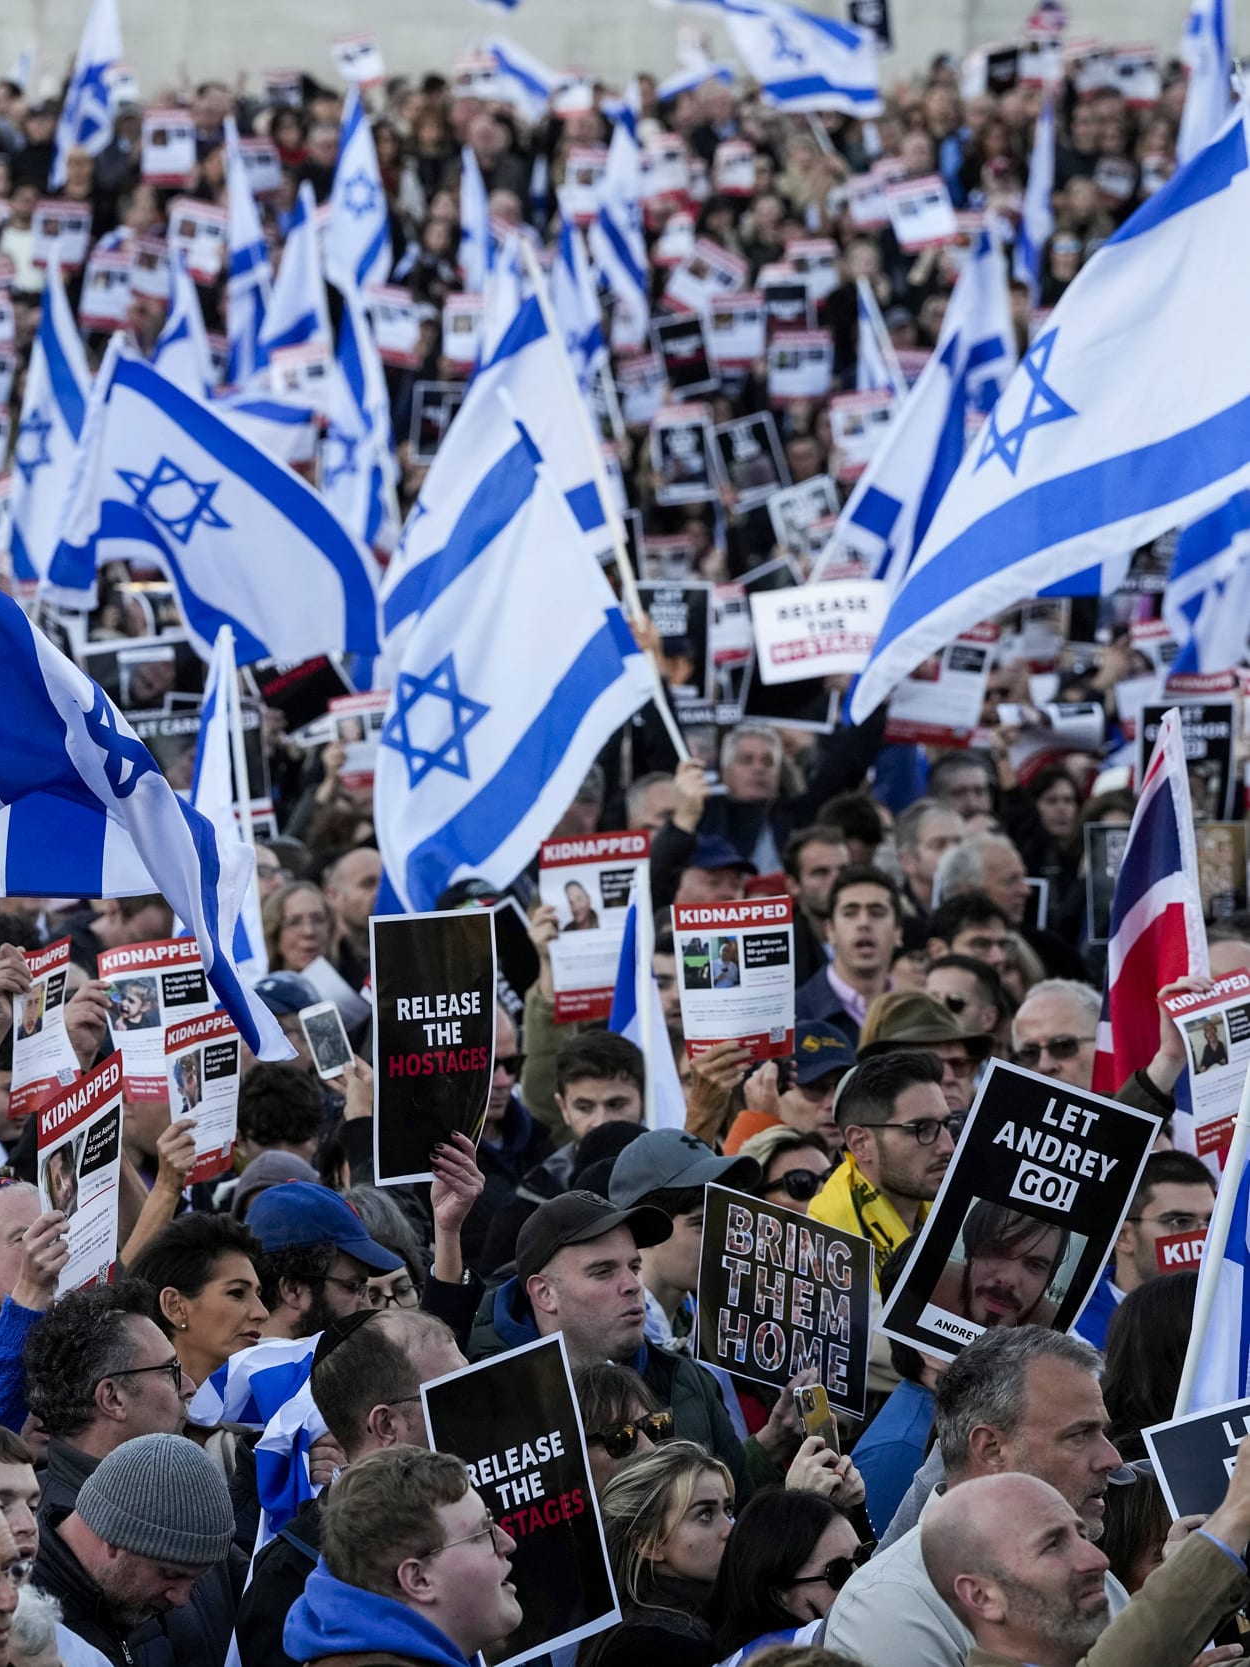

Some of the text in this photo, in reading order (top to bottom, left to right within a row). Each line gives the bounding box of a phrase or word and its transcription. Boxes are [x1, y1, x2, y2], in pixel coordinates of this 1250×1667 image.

[543, 836, 646, 861] KIDNAPPED
[679, 903, 788, 924] KIDNAPPED
[102, 942, 200, 971] KIDNAPPED
[396, 991, 481, 1021] RELEASE
[423, 1021, 463, 1047] THE
[388, 1046, 487, 1079] HOSTAGES
[41, 1062, 120, 1136] KIDNAPPED
[1042, 1097, 1100, 1138] LET
[992, 1120, 1119, 1183] ANDREY
[1017, 1168, 1073, 1208] GO!
[725, 1203, 852, 1291] BRING
[721, 1255, 851, 1344] THEM
[934, 1318, 981, 1341] ANDREY
[717, 1307, 849, 1396] HOME
[466, 1430, 565, 1488] RELEASE
[495, 1471, 545, 1510] THE
[499, 1488, 586, 1538] STAGES
